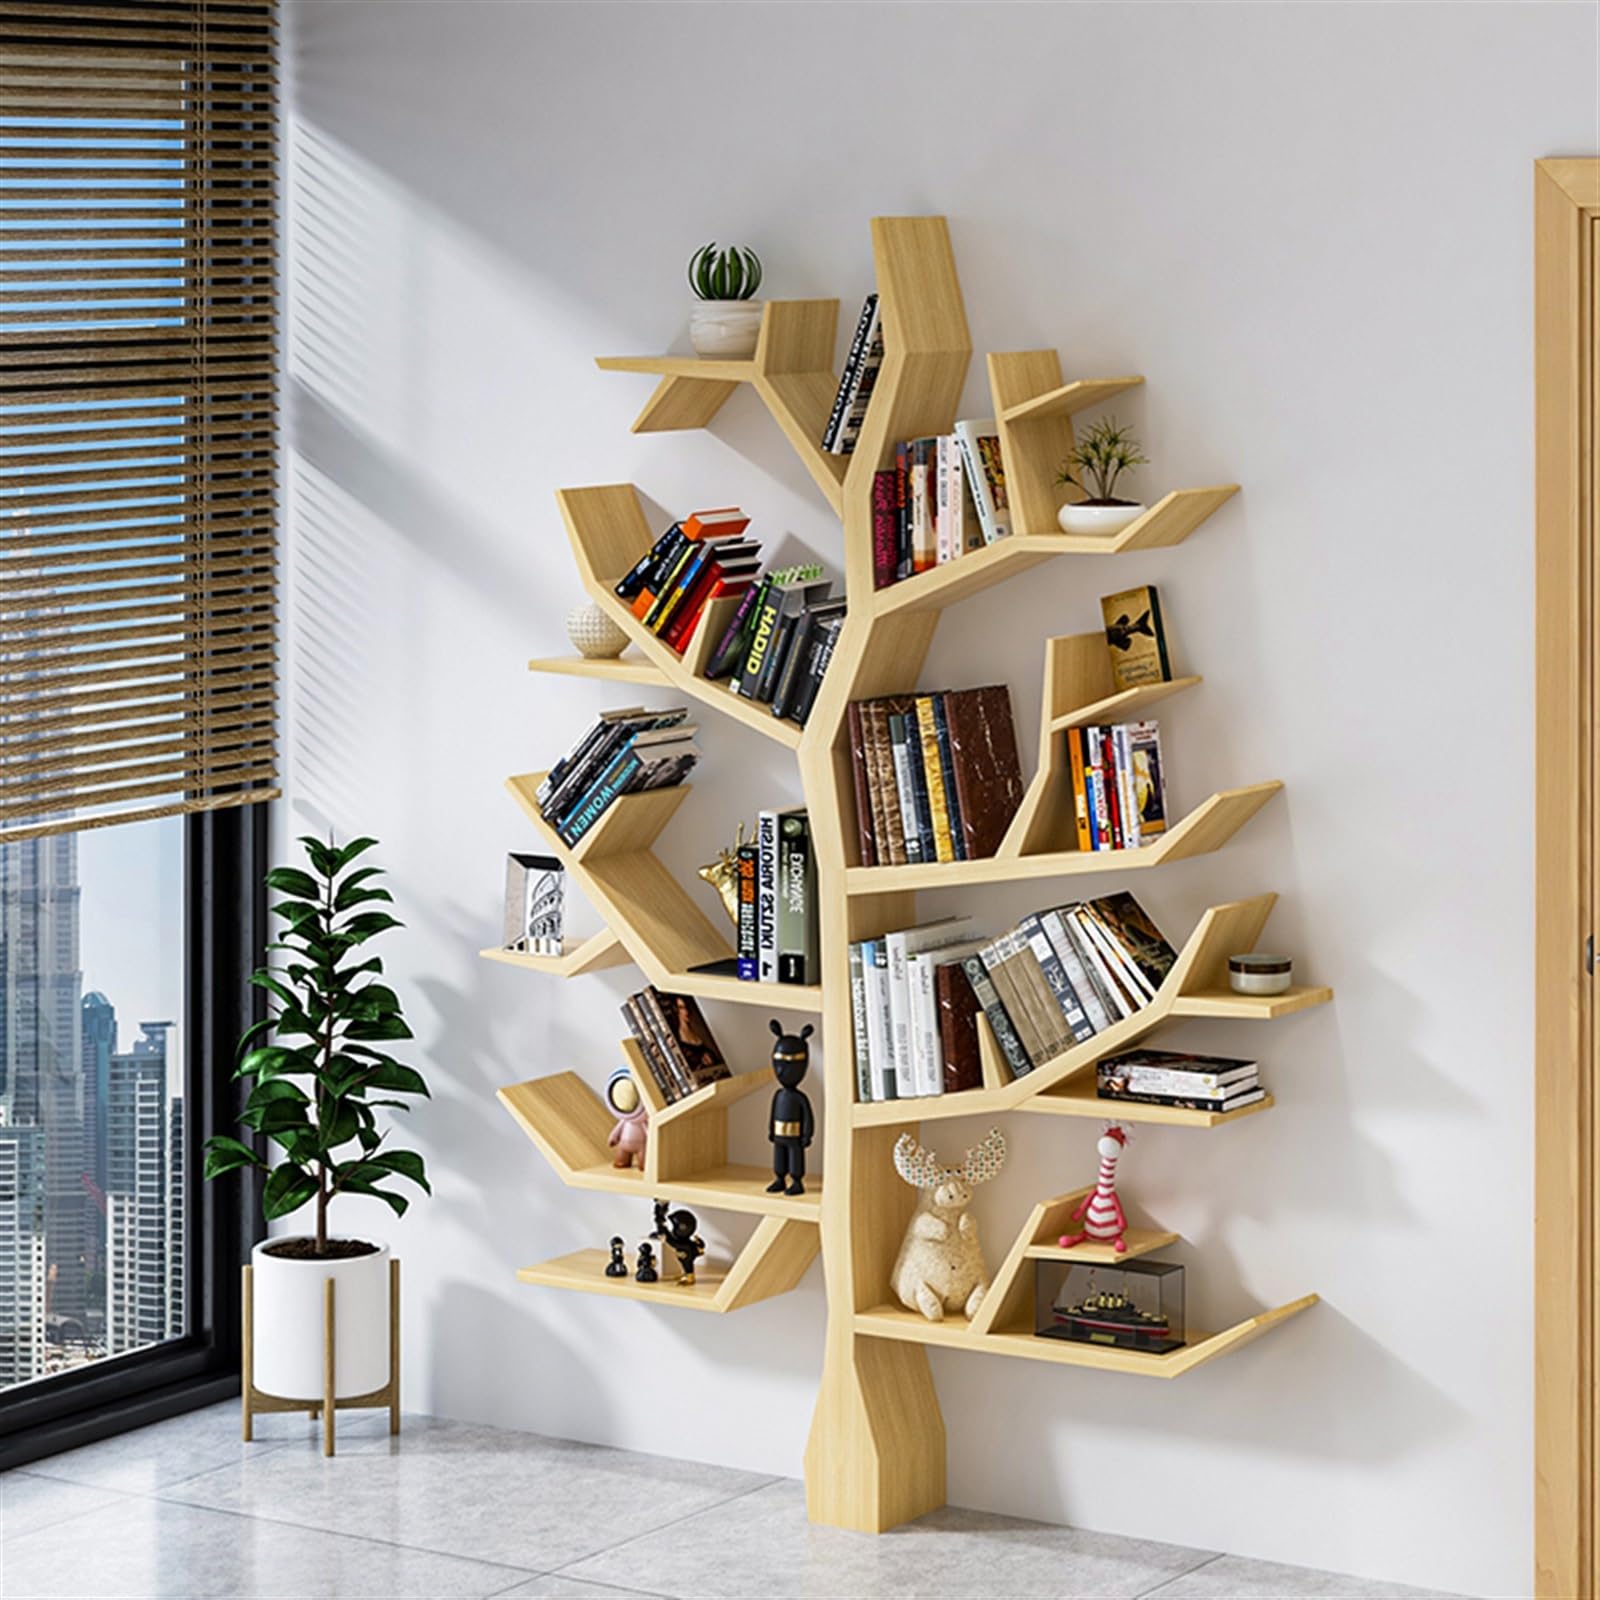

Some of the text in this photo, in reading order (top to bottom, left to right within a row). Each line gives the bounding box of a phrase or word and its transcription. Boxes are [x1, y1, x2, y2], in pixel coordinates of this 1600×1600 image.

[849, 303, 871, 367] ADOBE
[746, 605, 777, 675] HADID
[570, 785, 615, 838] WOMEN
